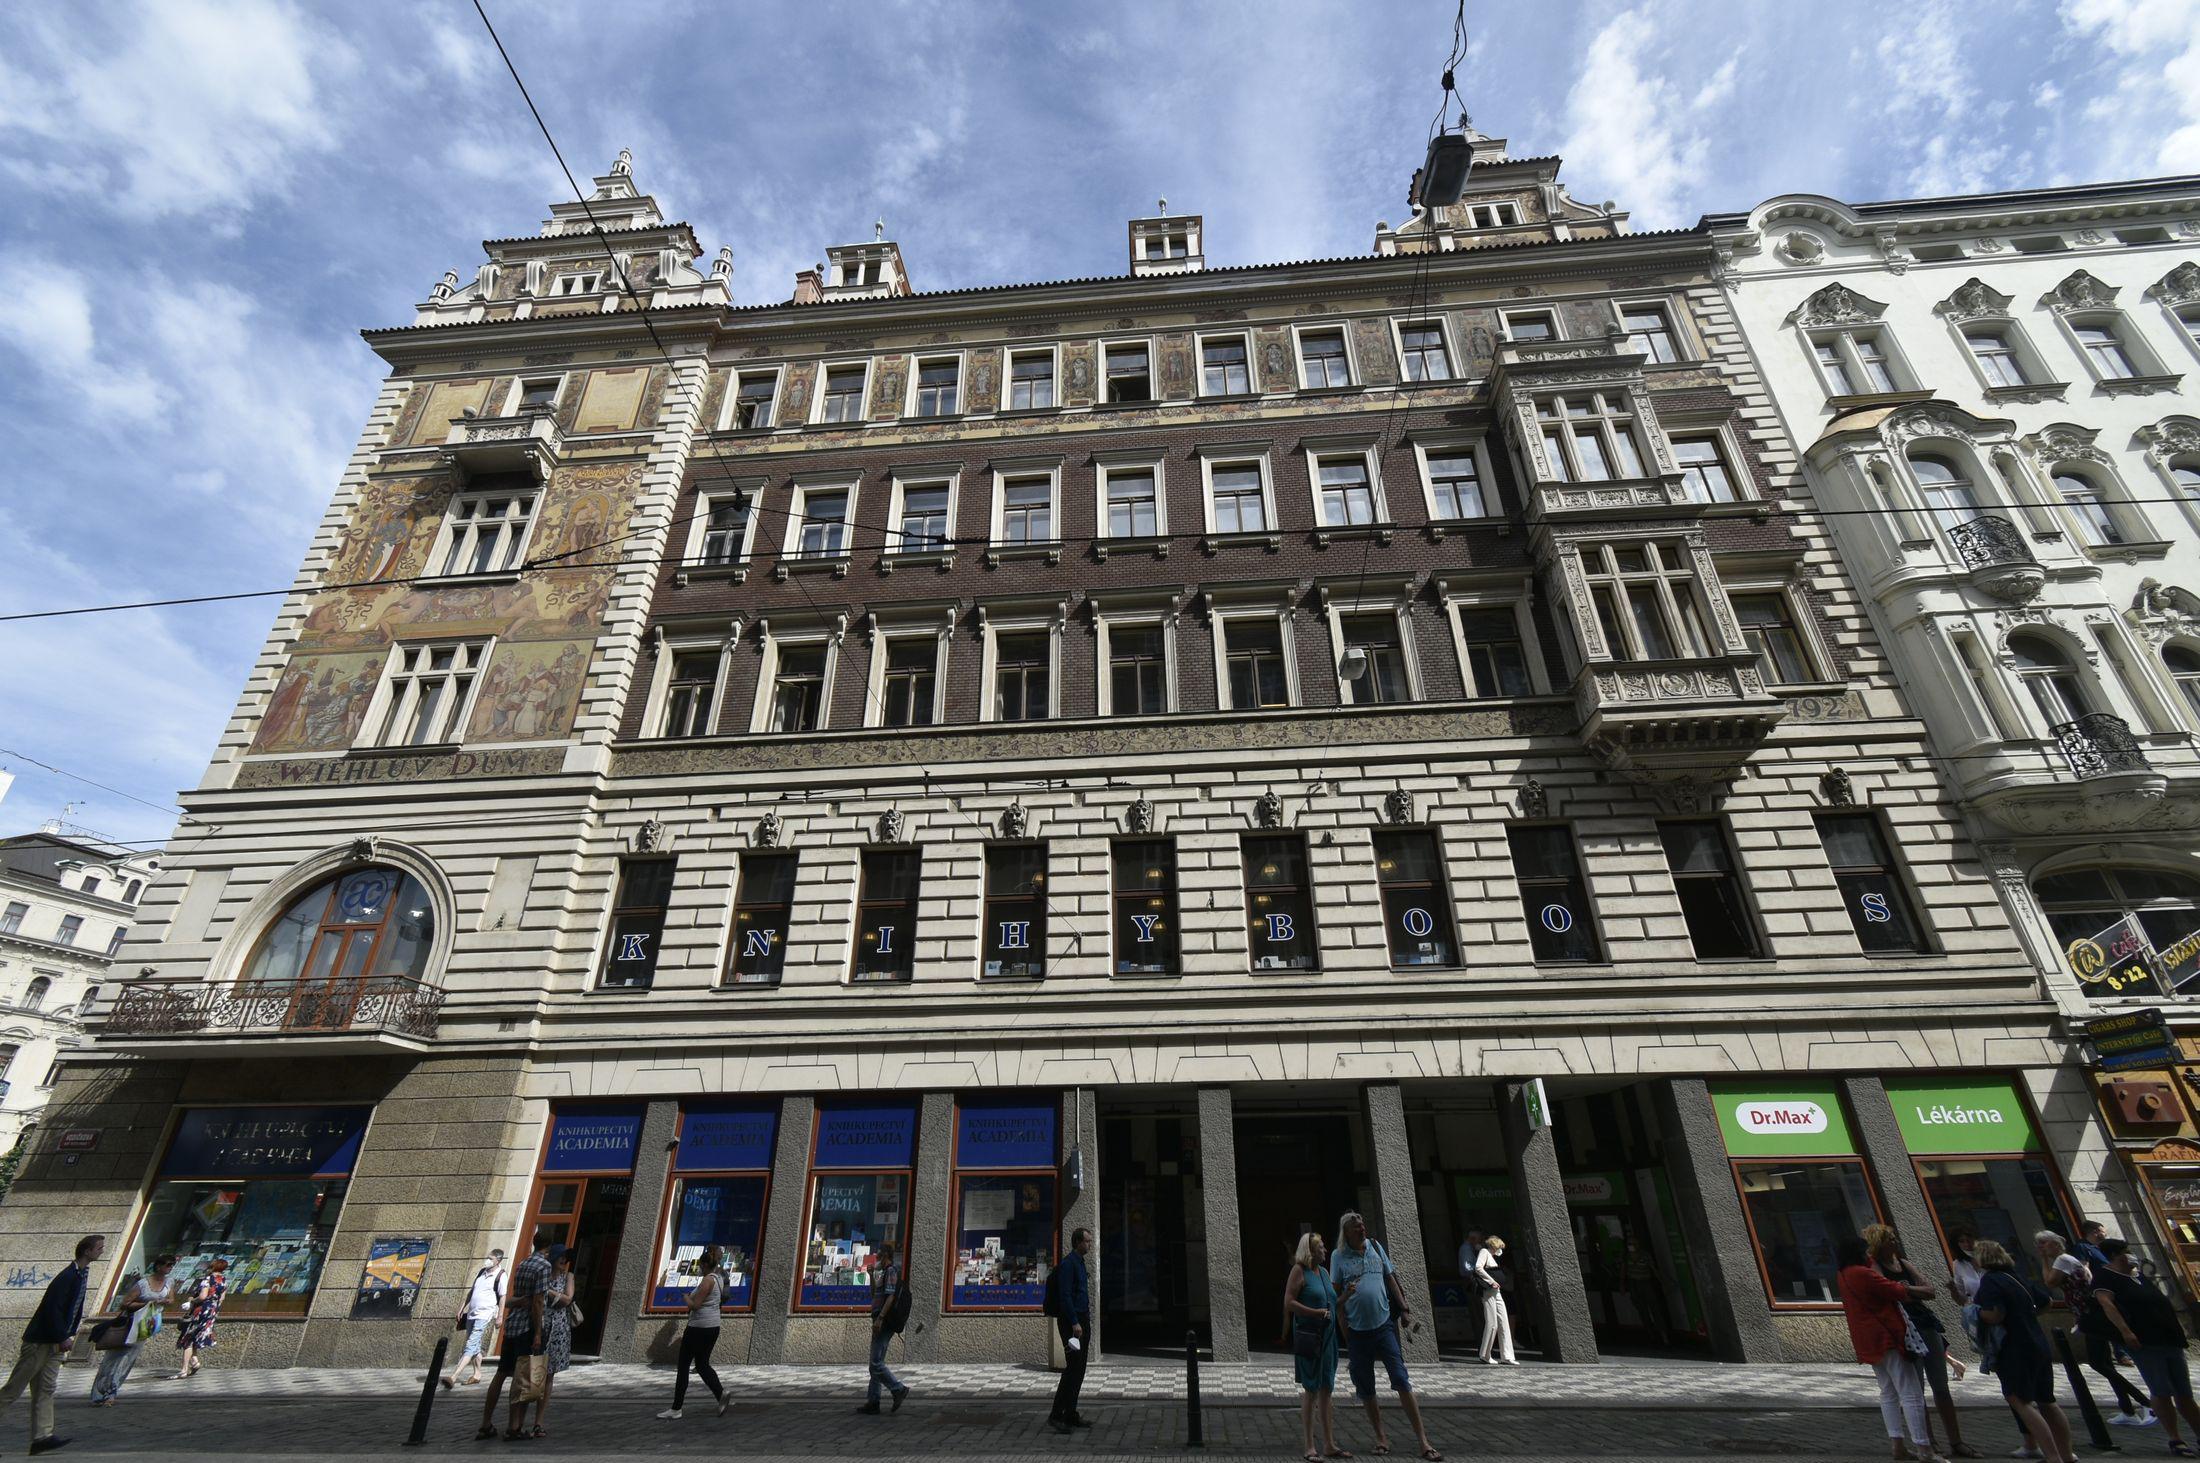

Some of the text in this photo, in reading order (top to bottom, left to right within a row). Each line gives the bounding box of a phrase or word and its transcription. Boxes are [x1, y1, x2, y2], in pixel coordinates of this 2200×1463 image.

[2088, 1015, 2137, 1034] CIGARS SHOP
[1750, 1109, 1813, 1126] Dr.Max
[1916, 1105, 2004, 1125] Lékárna
[558, 1123, 634, 1136] KNIHKUPECTVÍ
[828, 1118, 906, 1130] KNIHKUPECTVÍ
[688, 1134, 765, 1146] ACADEMIA
[826, 1132, 903, 1145] ACADEMIA
[967, 1130, 1047, 1143] ACADEMIA
[555, 1137, 629, 1150] ACADEMIA
